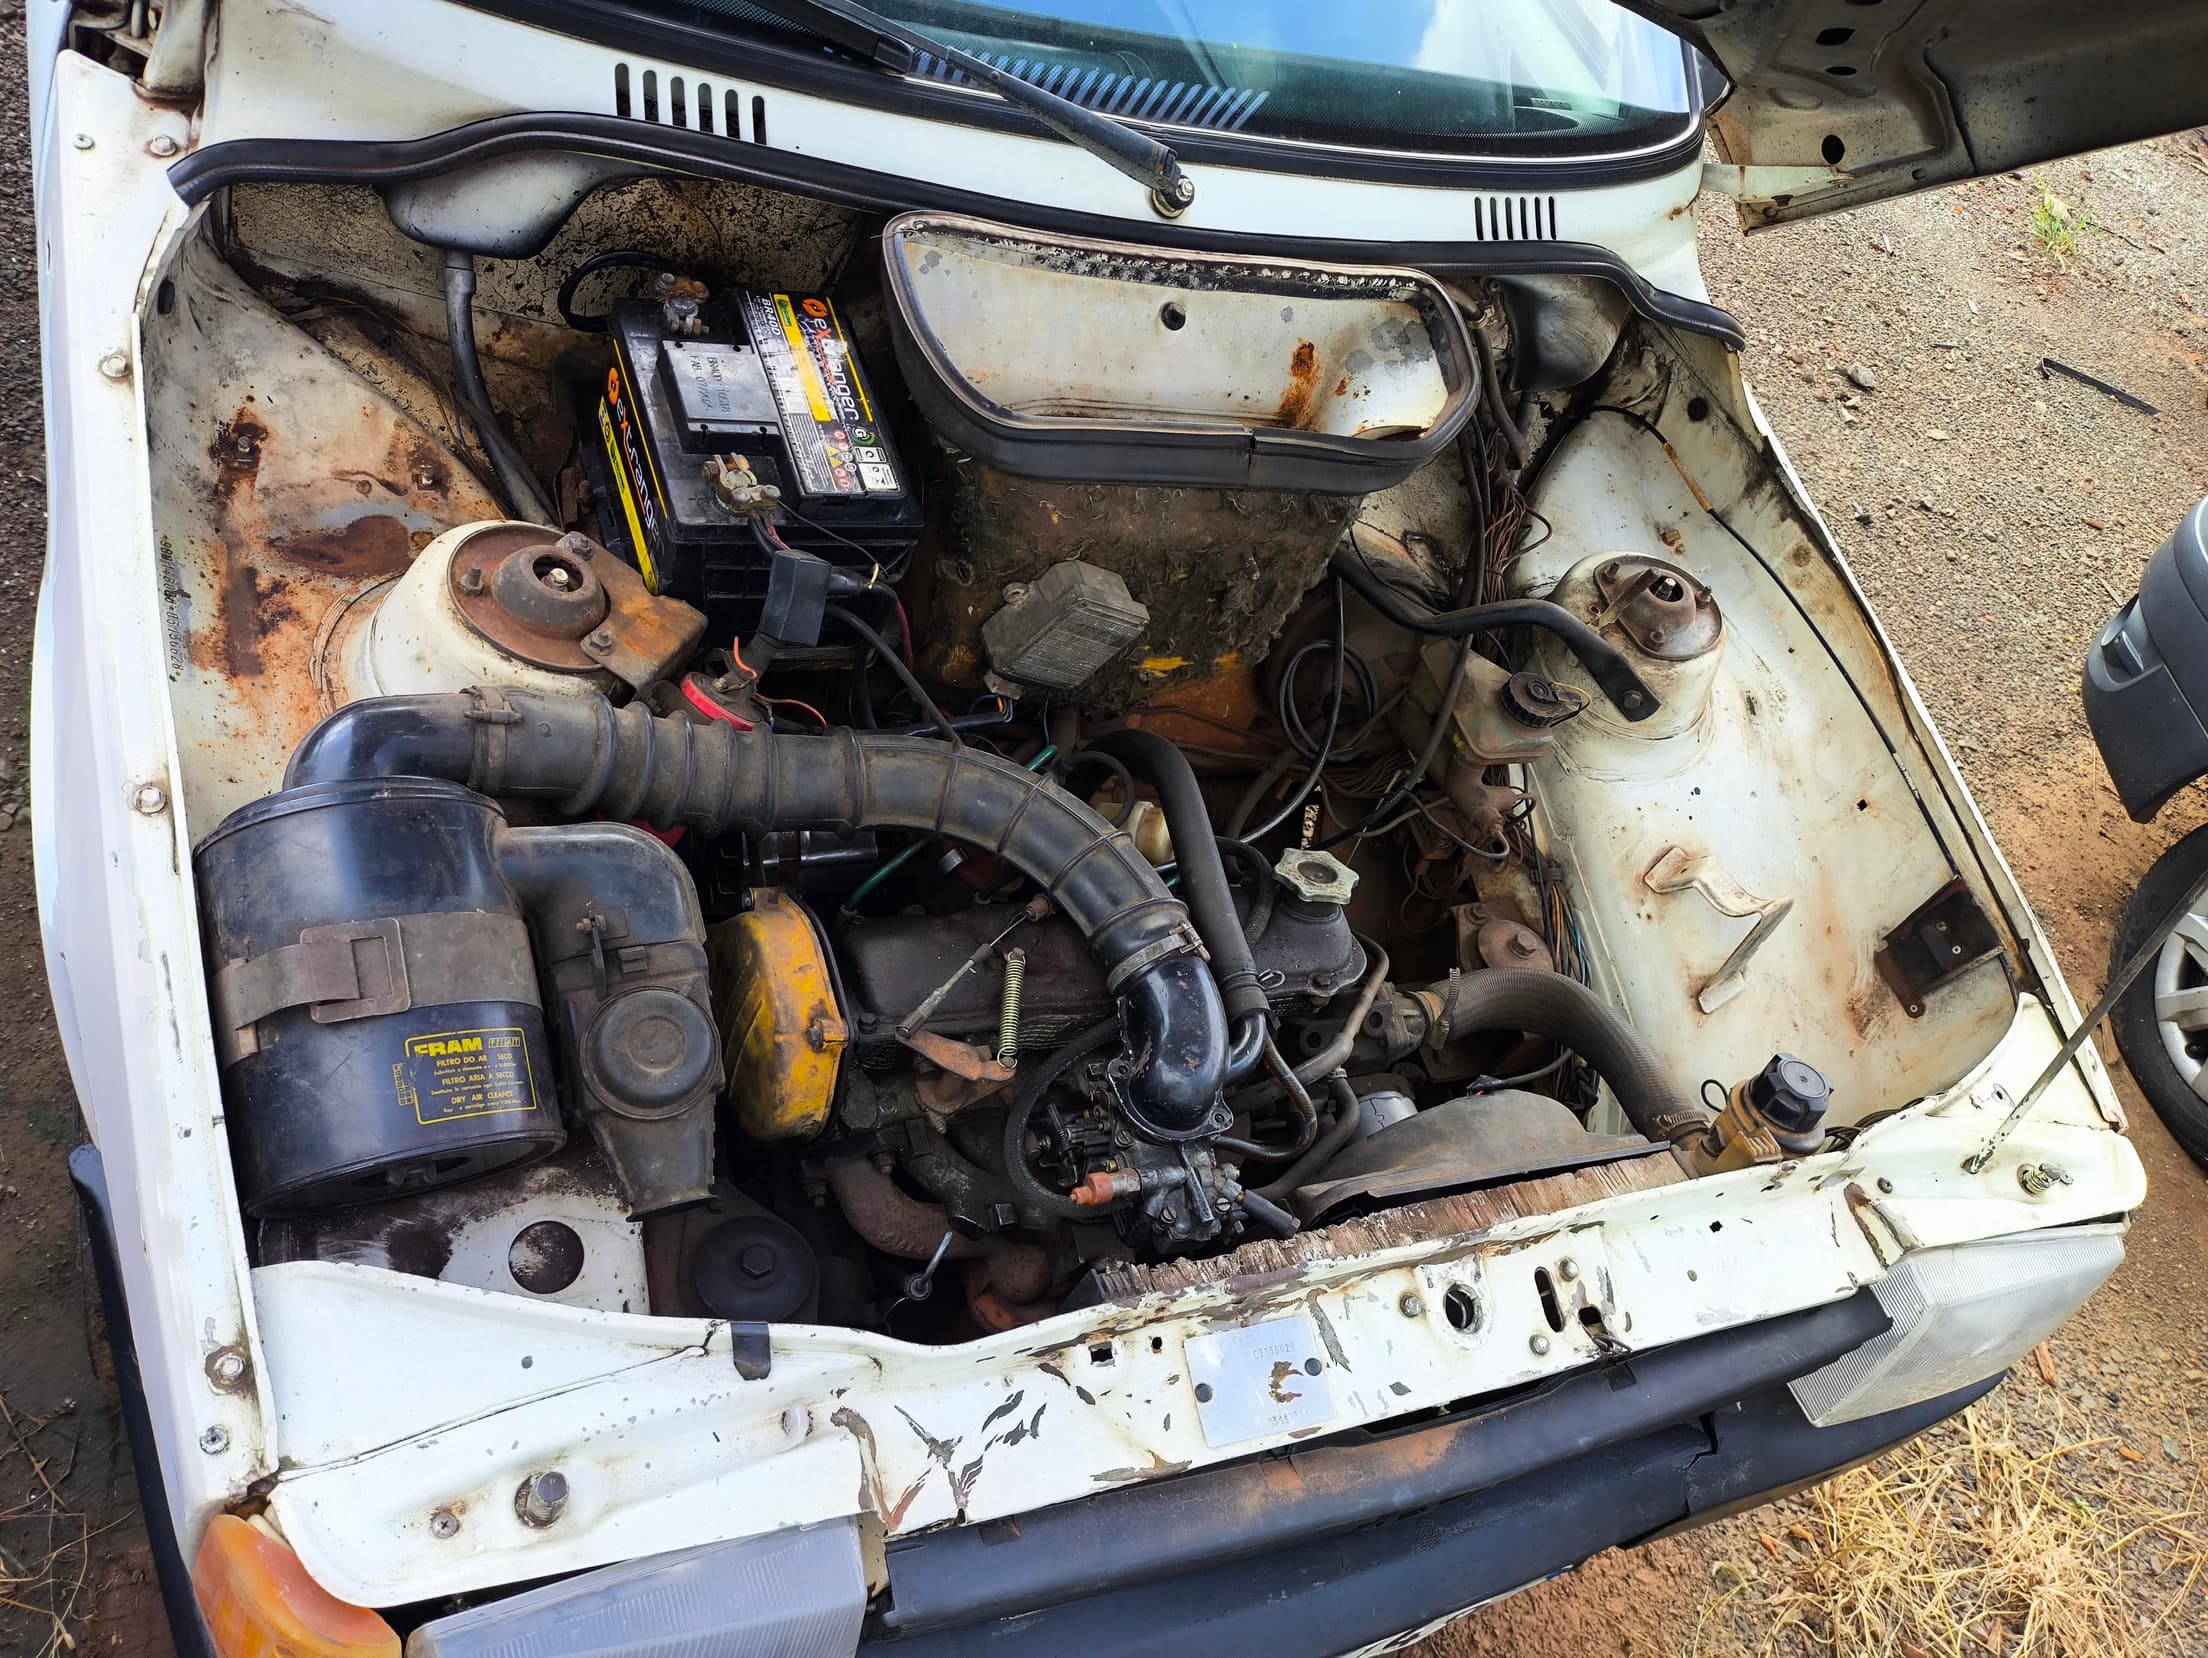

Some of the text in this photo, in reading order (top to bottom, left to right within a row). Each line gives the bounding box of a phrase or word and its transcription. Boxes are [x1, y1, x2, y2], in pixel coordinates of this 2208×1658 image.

[762, 298, 781, 336] BR40D
[413, 1036, 521, 1057] FRAM FIAT
[436, 1052, 513, 1068] FILTRO DO AR SECO
[441, 1074, 466, 1087] FILTRO
[488, 1072, 494, 1080] A
[495, 1071, 515, 1080] SECCO
[450, 1095, 466, 1106] DRY
[471, 1092, 484, 1103] AIR
